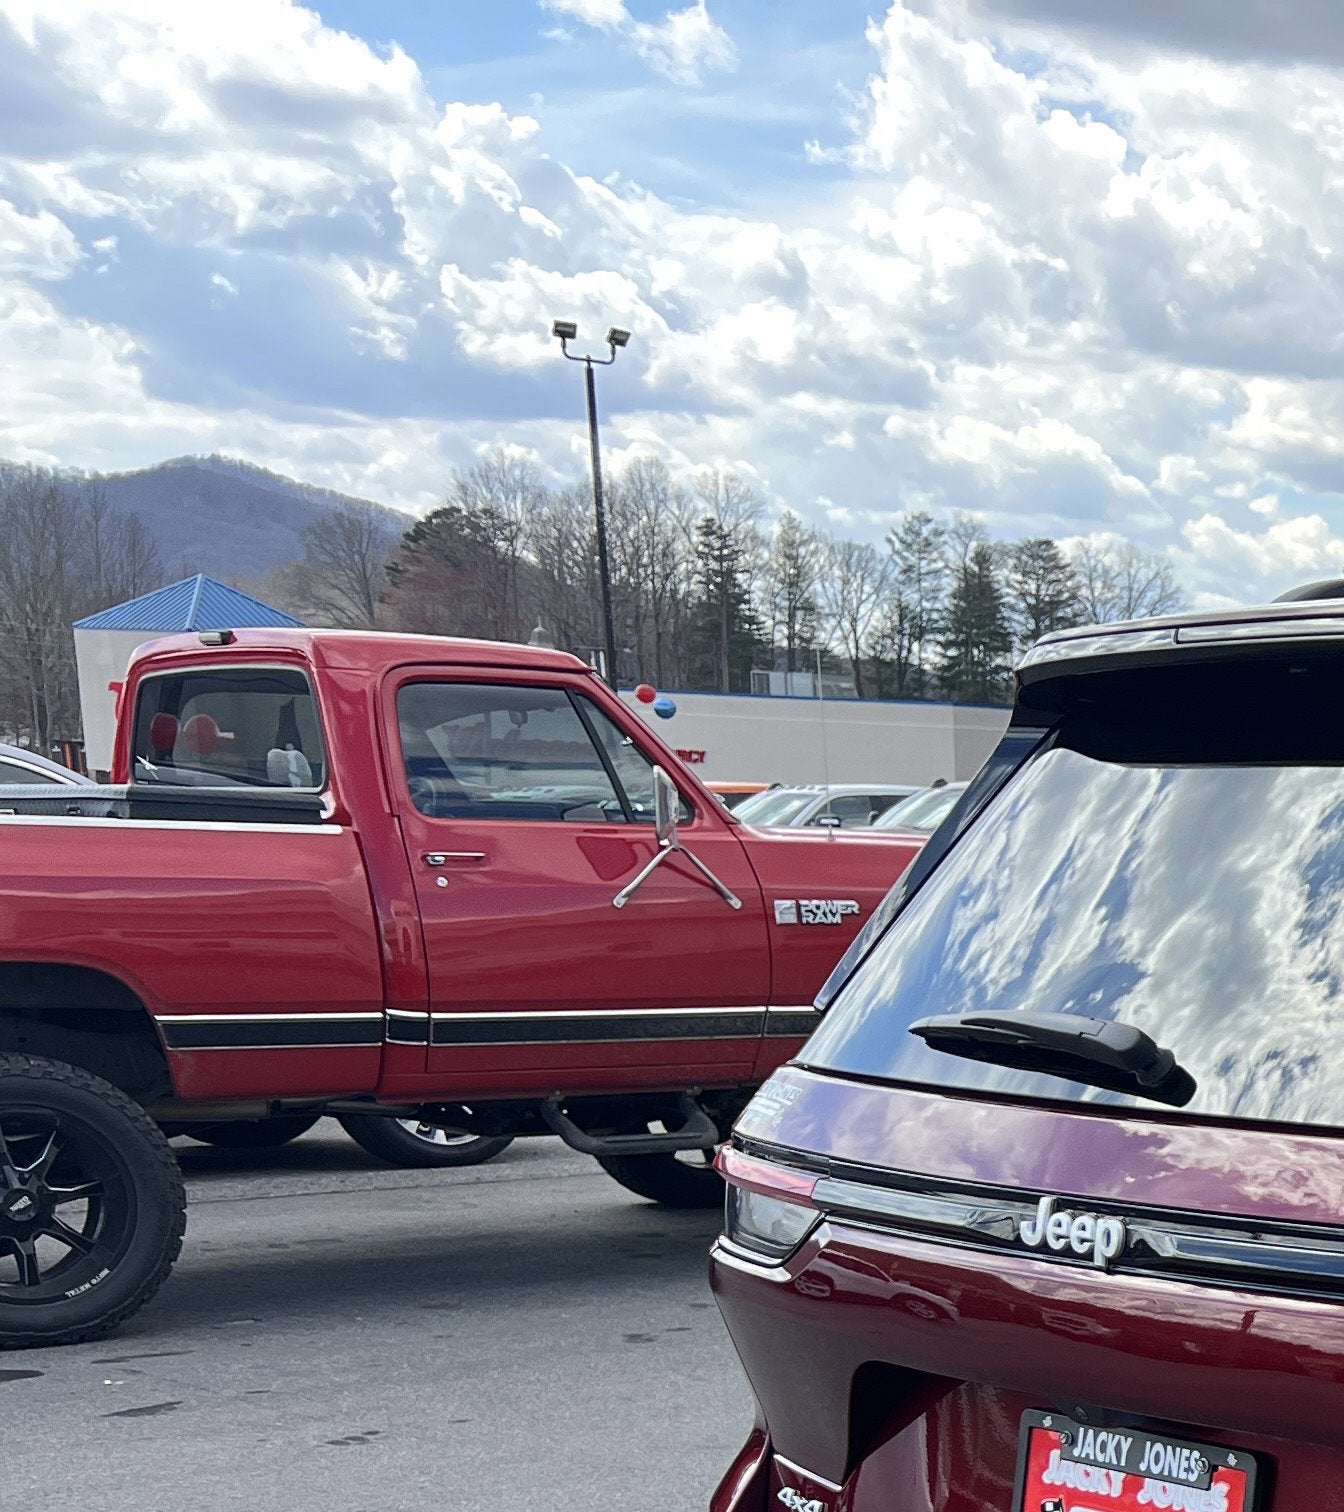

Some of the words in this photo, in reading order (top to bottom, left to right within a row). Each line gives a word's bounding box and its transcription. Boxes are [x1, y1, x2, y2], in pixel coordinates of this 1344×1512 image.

[799, 900, 860, 914] POWER
[801, 912, 842, 924] RAM
[1020, 1195, 1125, 1269] Jeep
[1072, 1427, 1134, 1467] JACKY
[1139, 1440, 1201, 1482] JONES
